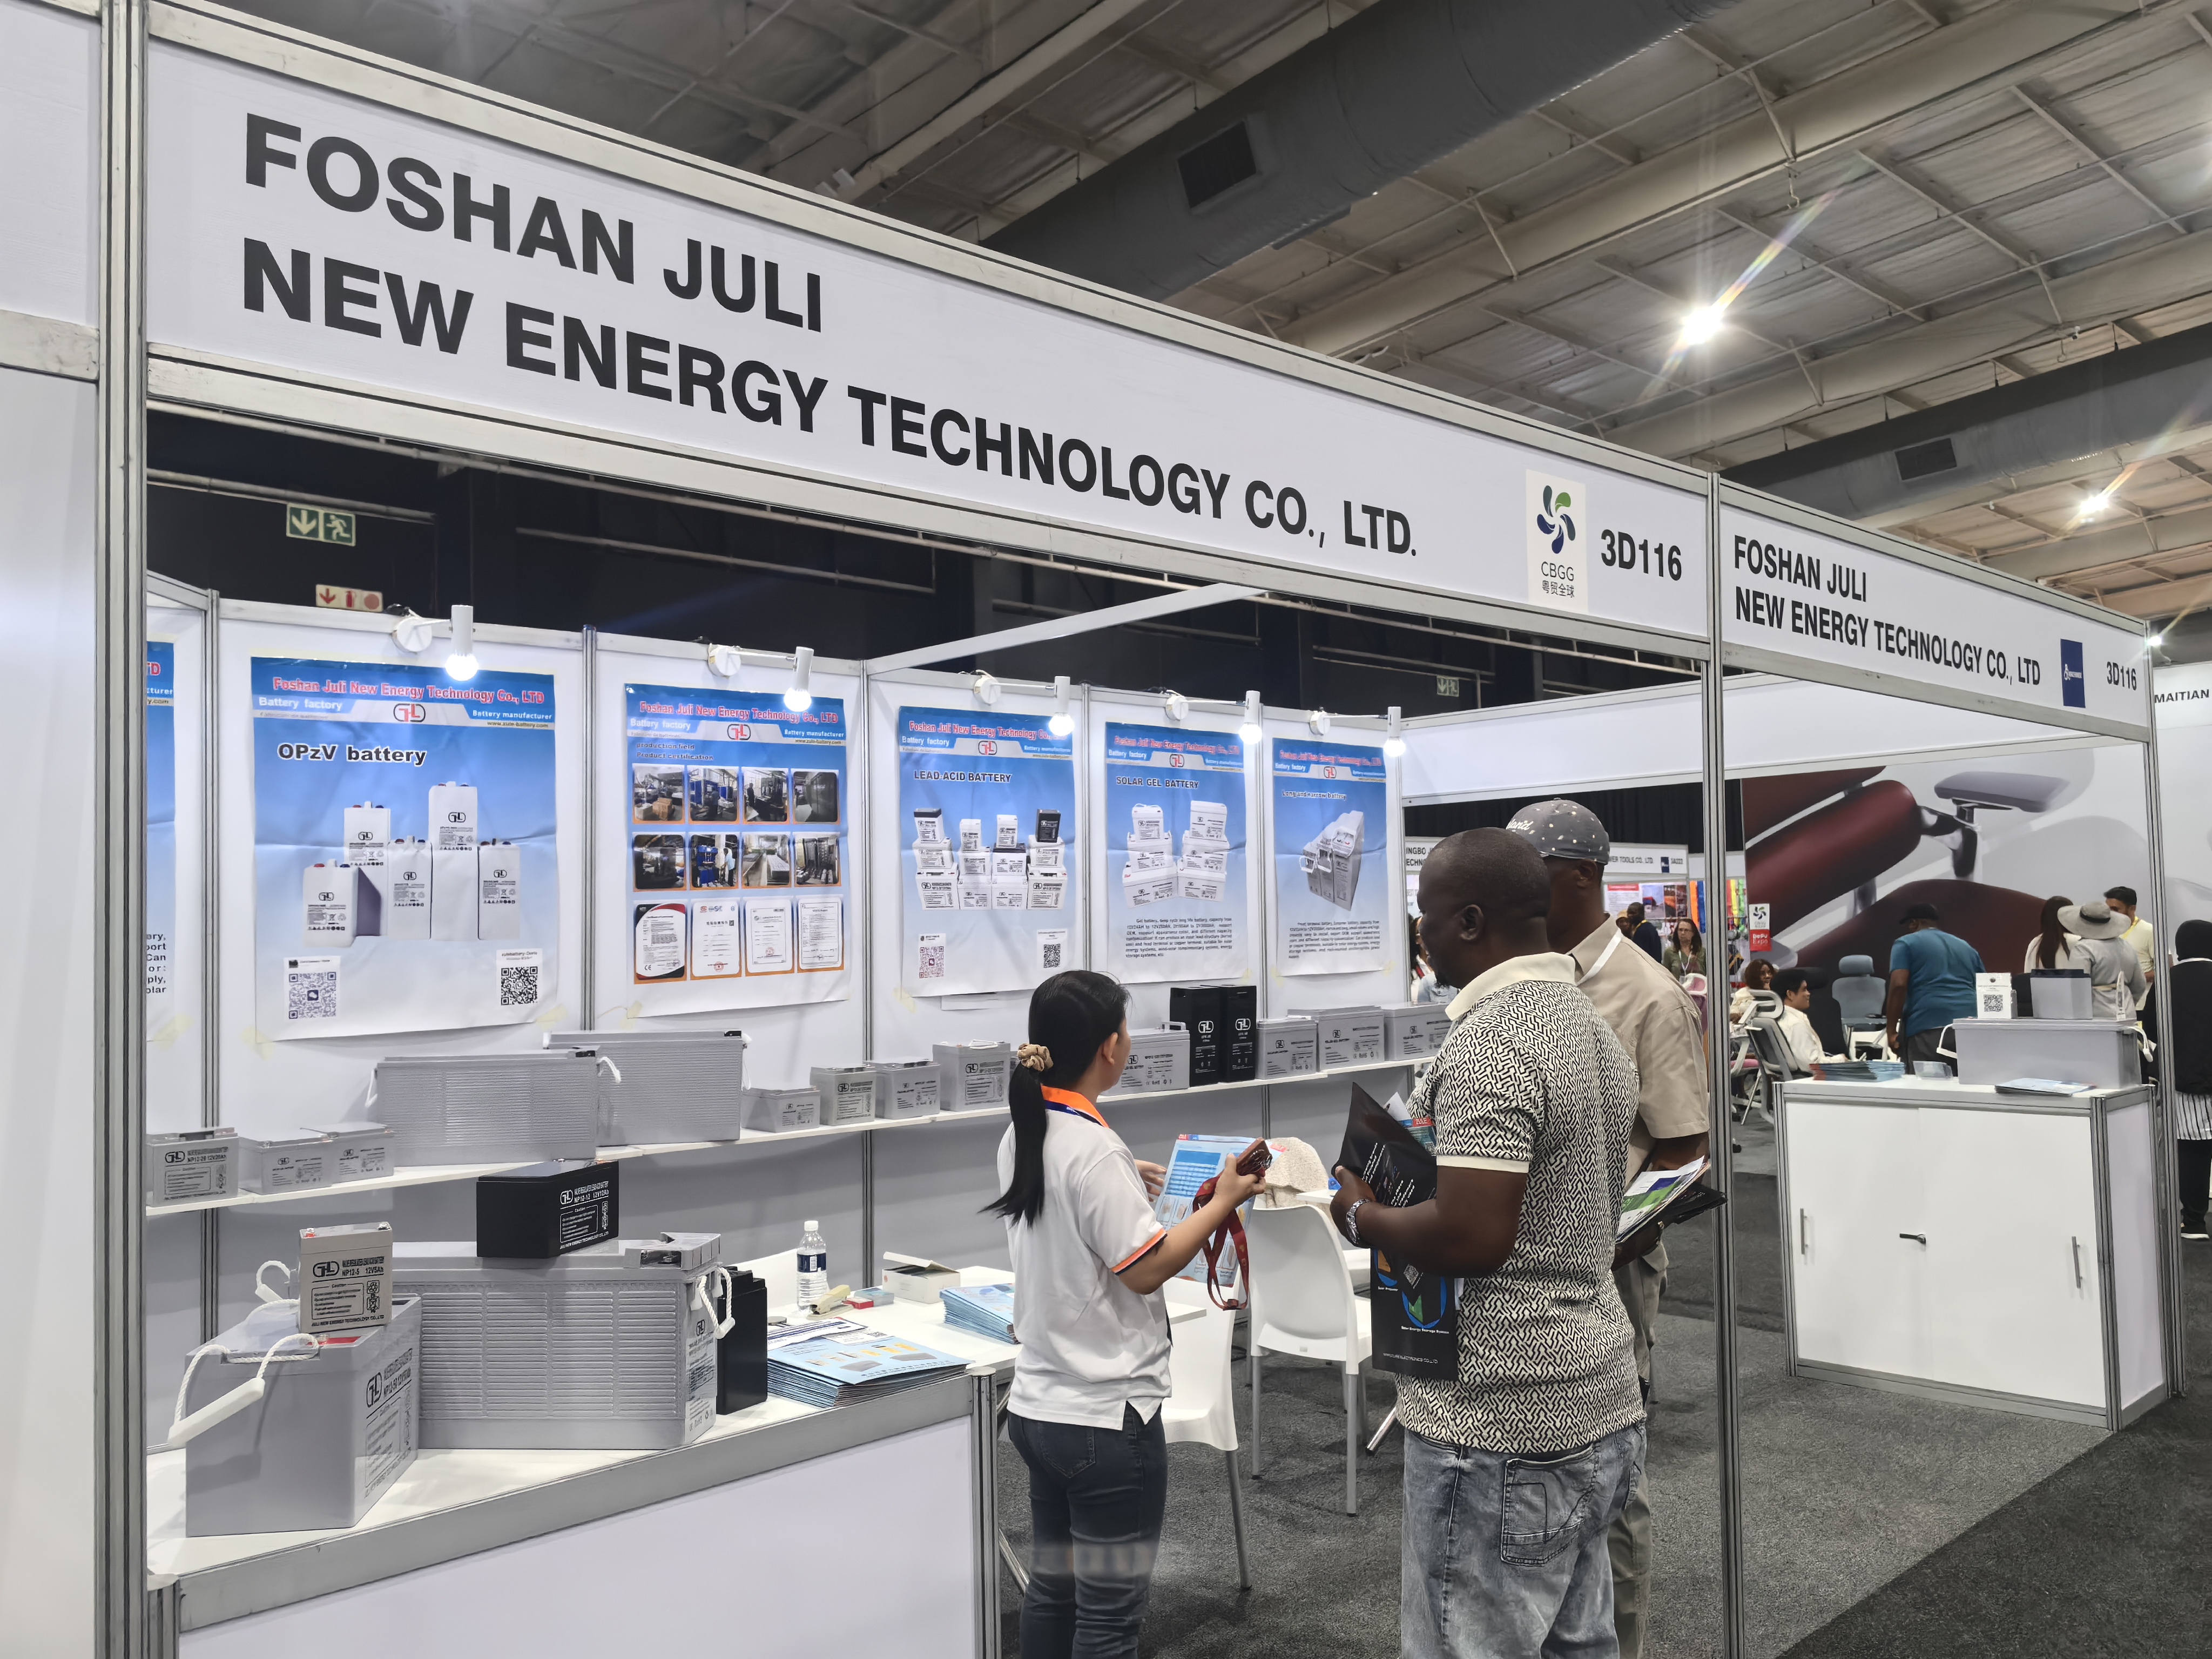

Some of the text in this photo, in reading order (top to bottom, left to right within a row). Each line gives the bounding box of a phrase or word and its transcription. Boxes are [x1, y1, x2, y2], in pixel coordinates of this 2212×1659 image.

[246, 112, 821, 333] FOSHAN JULI
[244, 237, 1417, 557] NEW ENERGY TECHNOLOGY CO., LTD.
[1601, 529, 1682, 581] 3D116
[1541, 561, 1574, 582] CBGG
[1735, 535, 1866, 602] FOSHAN JULI
[1542, 580, 1575, 598] 粤贸全球
[1736, 586, 2041, 685] NEW ENERGY TECHNOLOGY CO., LTD
[2107, 661, 2137, 691] 3D116
[273, 677, 545, 705] Foshan Juli New Energy Technology Co., LTD
[2155, 689, 2209, 703] MAITIAN
[259, 697, 343, 711] Battery factory
[473, 710, 501, 719] Battery
[640, 701, 673, 714] Foshan
[696, 705, 716, 716] New
[718, 706, 750, 720] Energy
[752, 707, 800, 724] Technology
[820, 712, 839, 723] LTD
[630, 718, 691, 731] Battery factory
[971, 725, 996, 738] Energy
[927, 738, 949, 747] factory
[278, 743, 427, 765] OPzV battery
[968, 772, 1011, 783] BATTERY
[1116, 777, 1199, 790] SOLAR GEL BATTERY
